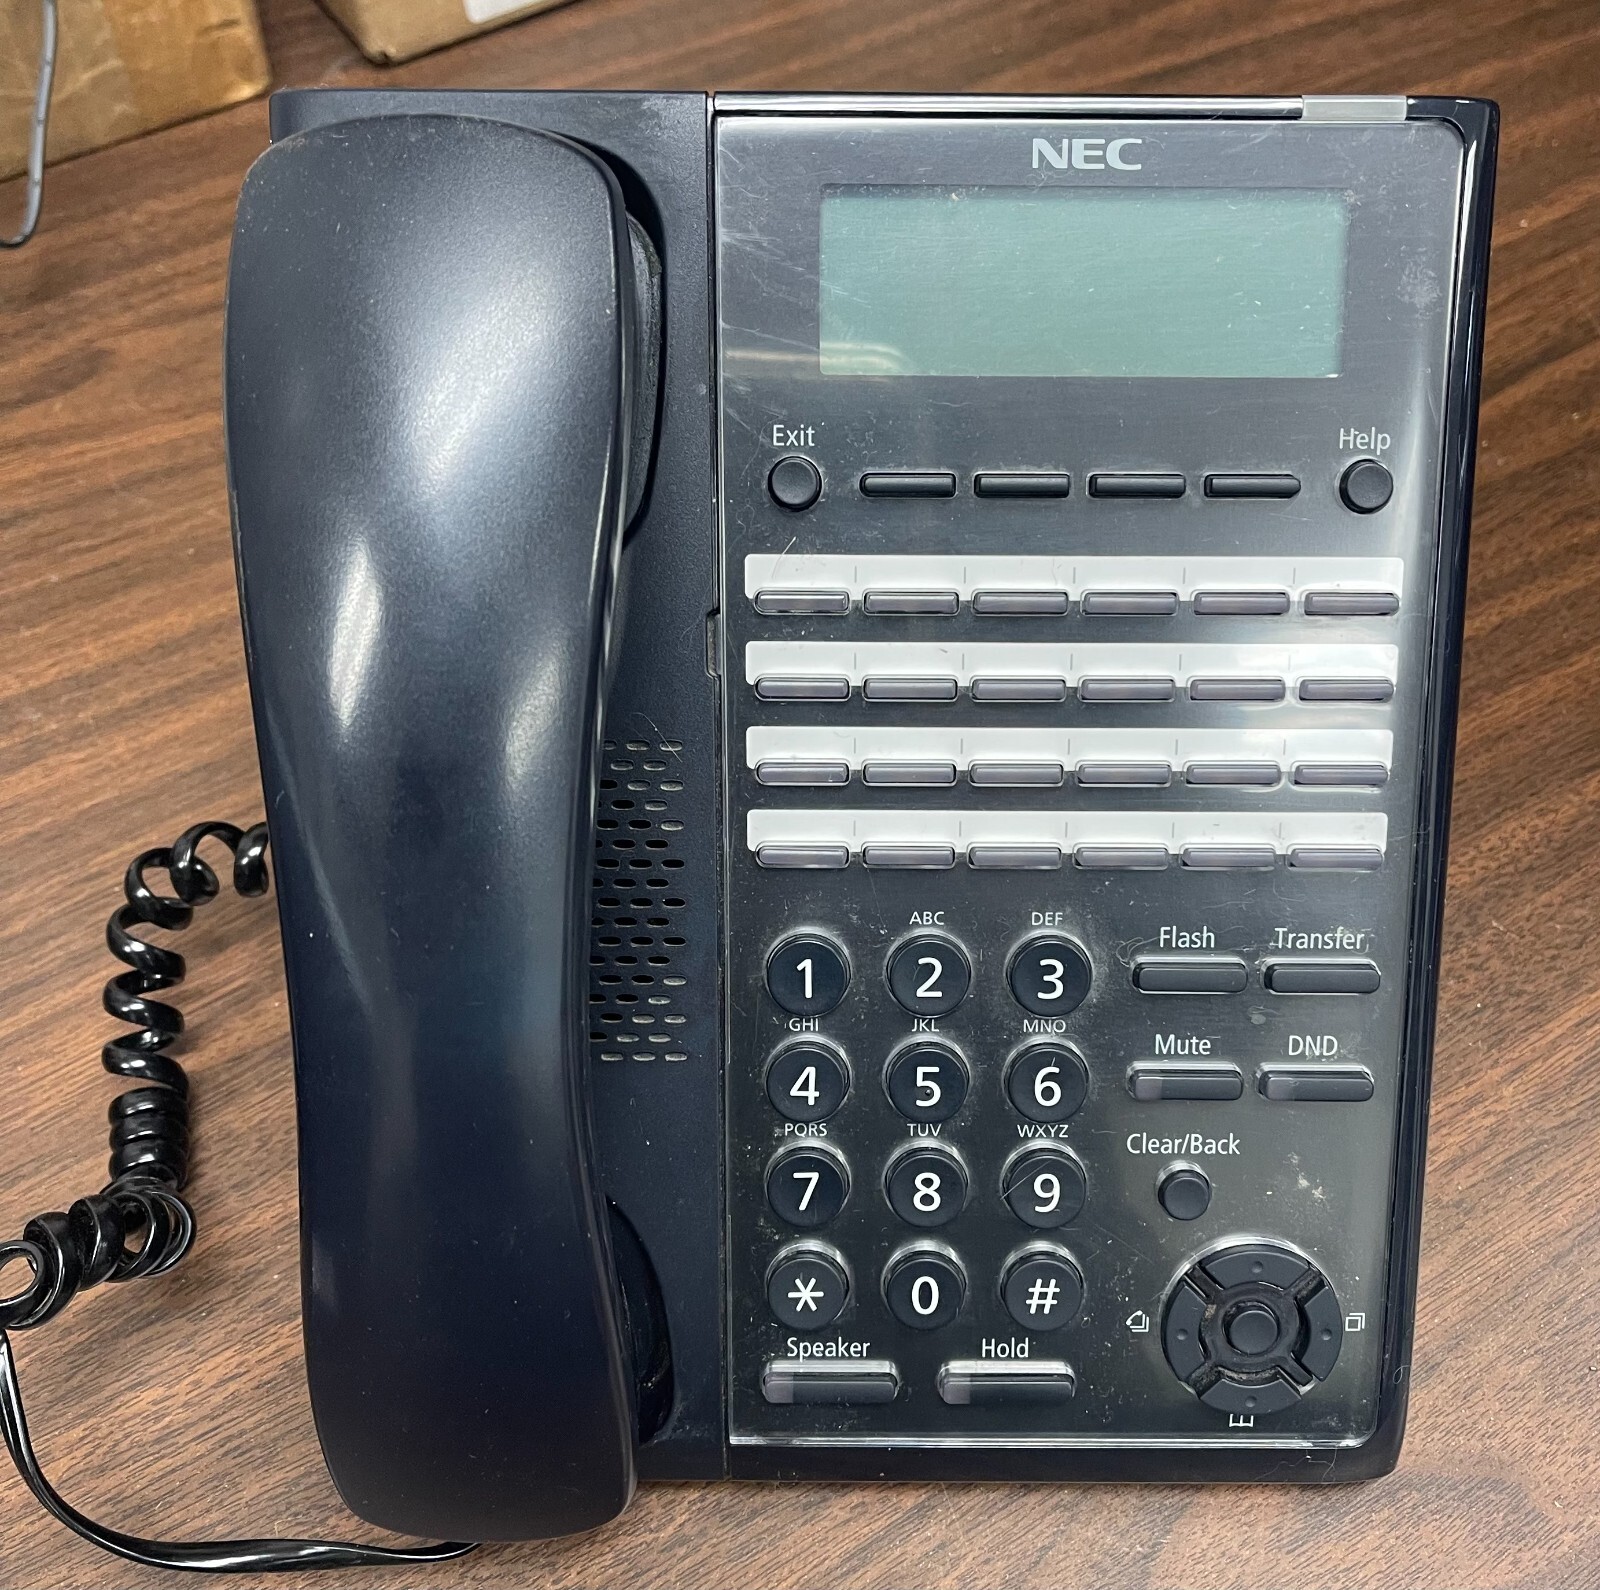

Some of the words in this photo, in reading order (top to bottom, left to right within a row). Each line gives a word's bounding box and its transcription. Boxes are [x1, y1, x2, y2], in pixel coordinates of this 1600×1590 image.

[1032, 138, 1142, 170] NEC
[773, 424, 815, 446] Exit
[1339, 426, 1391, 456] Help
[909, 911, 945, 926] ABC
[1031, 912, 1063, 926] DEF
[1159, 926, 1215, 948] Flash
[1274, 927, 1365, 949] Transfer
[796, 958, 813, 998] 1
[916, 957, 943, 998] 2
[1037, 958, 1064, 1000] 3
[788, 1018, 819, 1032] GHI
[911, 1018, 940, 1032] JKL
[1023, 1019, 1067, 1033] MNO
[1154, 1034, 1211, 1055] Mute
[1288, 1035, 1338, 1055] DND
[790, 1066, 820, 1106] 4
[915, 1066, 941, 1106] 5
[1034, 1066, 1061, 1106] 6
[784, 1123, 828, 1138] PQRS
[907, 1124, 942, 1138] TUV
[1017, 1124, 1069, 1138] WXYZ
[1126, 1133, 1240, 1155] Clear/Back
[793, 1172, 820, 1211] 7
[913, 1172, 941, 1212] 8
[1033, 1173, 1060, 1213] 9
[911, 1275, 939, 1315] 0
[1025, 1278, 1060, 1314] #
[787, 1337, 871, 1362] Speaker
[981, 1338, 1029, 1358] Hold
